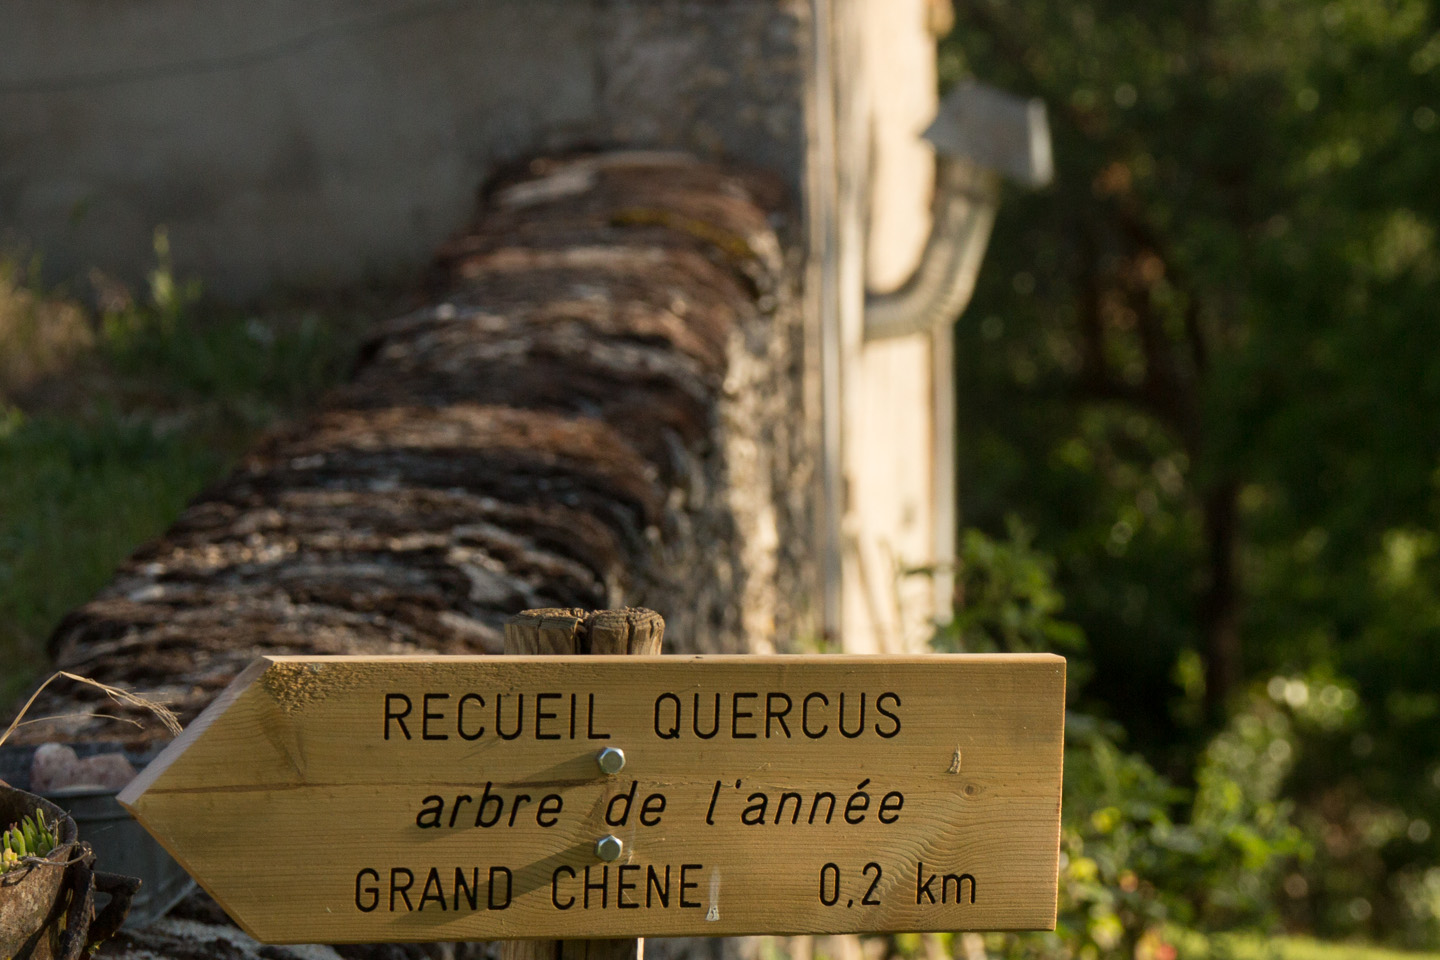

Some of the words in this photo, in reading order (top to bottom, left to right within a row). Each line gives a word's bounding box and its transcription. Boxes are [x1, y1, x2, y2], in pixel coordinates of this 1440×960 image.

[384, 693, 611, 740] RECUEIL
[654, 692, 902, 740] QUERCUS
[416, 781, 564, 829] arbre
[605, 780, 667, 827] de
[706, 778, 904, 825] l'année
[355, 866, 513, 912] GRAND
[552, 864, 703, 910] CHENE
[819, 862, 882, 908] 0,2
[915, 861, 977, 905] km
